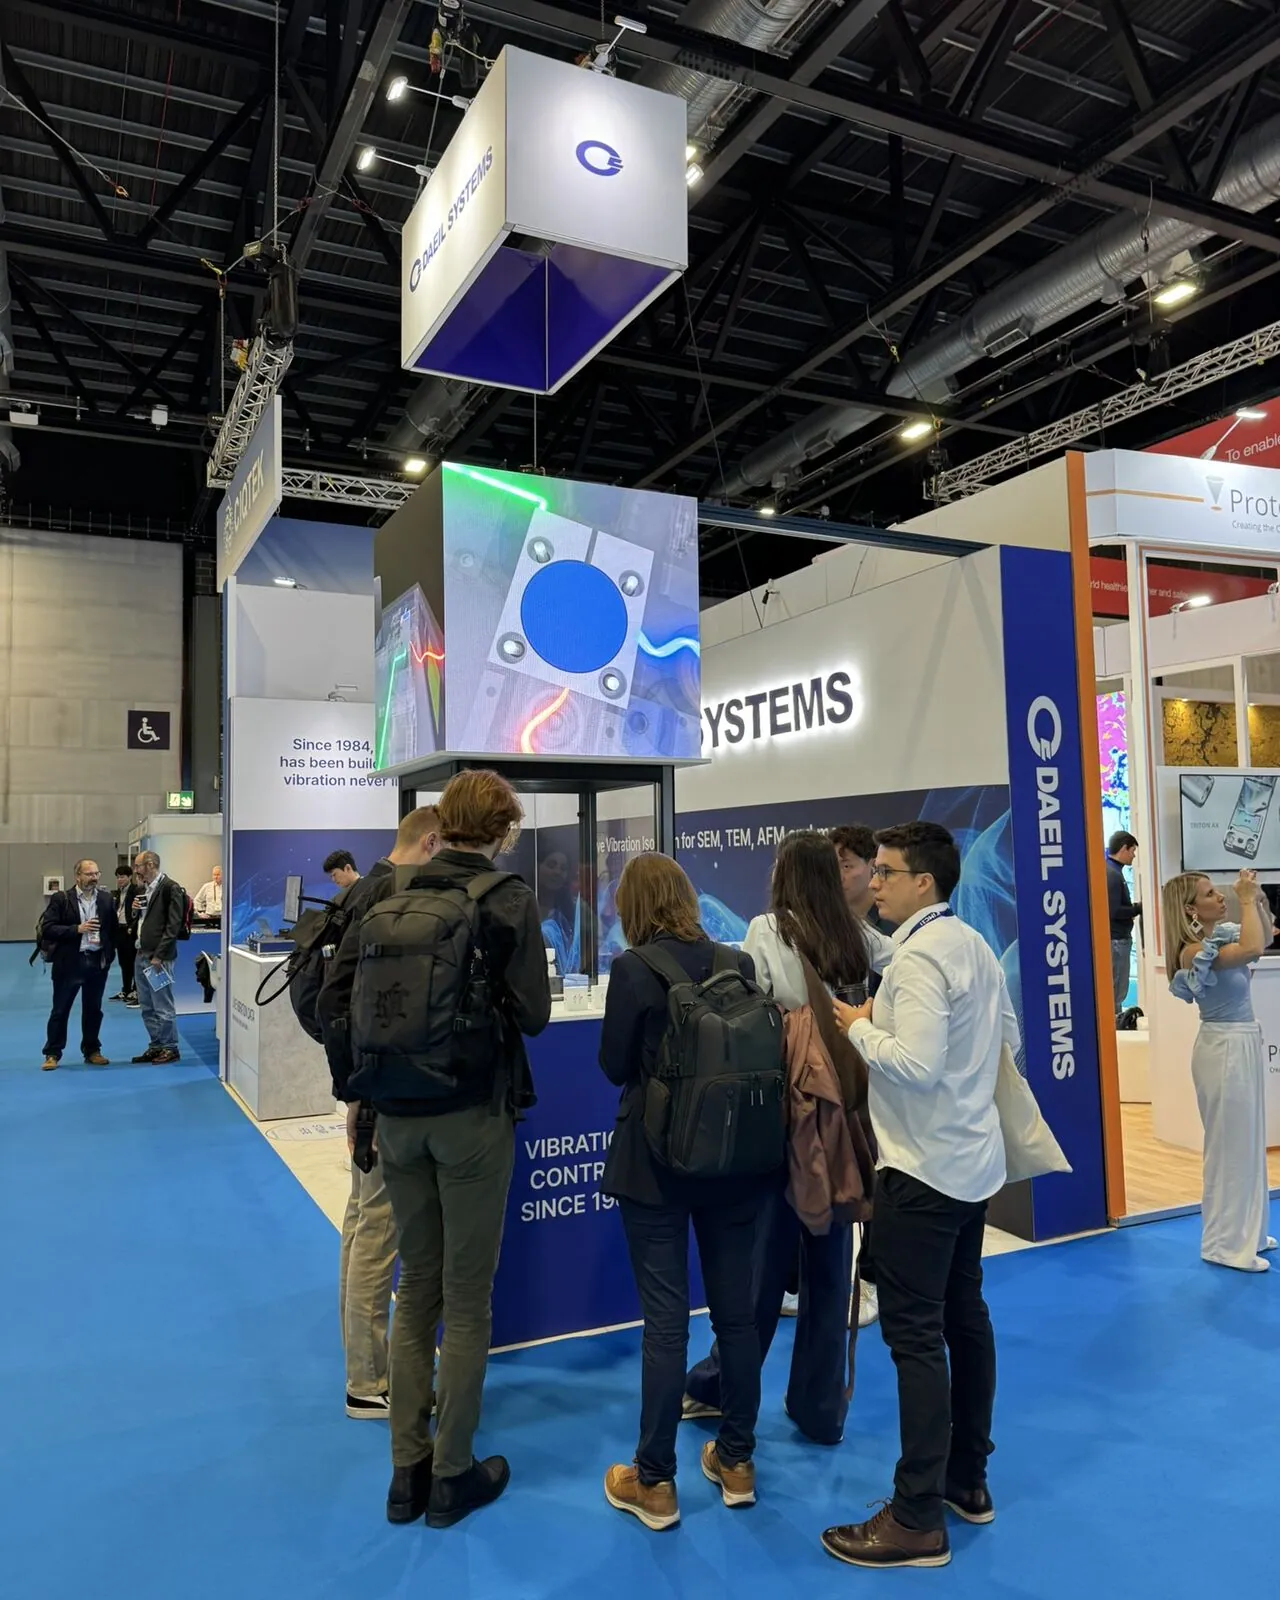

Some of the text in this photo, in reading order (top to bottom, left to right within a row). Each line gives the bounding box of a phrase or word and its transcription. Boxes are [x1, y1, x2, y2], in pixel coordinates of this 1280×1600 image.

[422, 145, 493, 271] DAEIL SYSTEMS
[1225, 448, 1240, 463] To
[1230, 489, 1280, 517] Prot
[700, 671, 853, 748] YSTEMS
[293, 738, 374, 755] Since 1984,
[280, 756, 306, 768] has
[310, 757, 344, 769] been
[284, 773, 346, 787] vibration
[350, 776, 387, 787] never
[605, 835, 641, 853] Vibration
[681, 831, 696, 849] for
[697, 829, 724, 852] SEM,
[725, 827, 754, 851] TEM,
[757, 825, 786, 846] AFM
[1035, 766, 1075, 1080] DAEIL SYSTEMS
[530, 1161, 606, 1190] CONTR
[520, 1191, 620, 1222] SINCE 19
